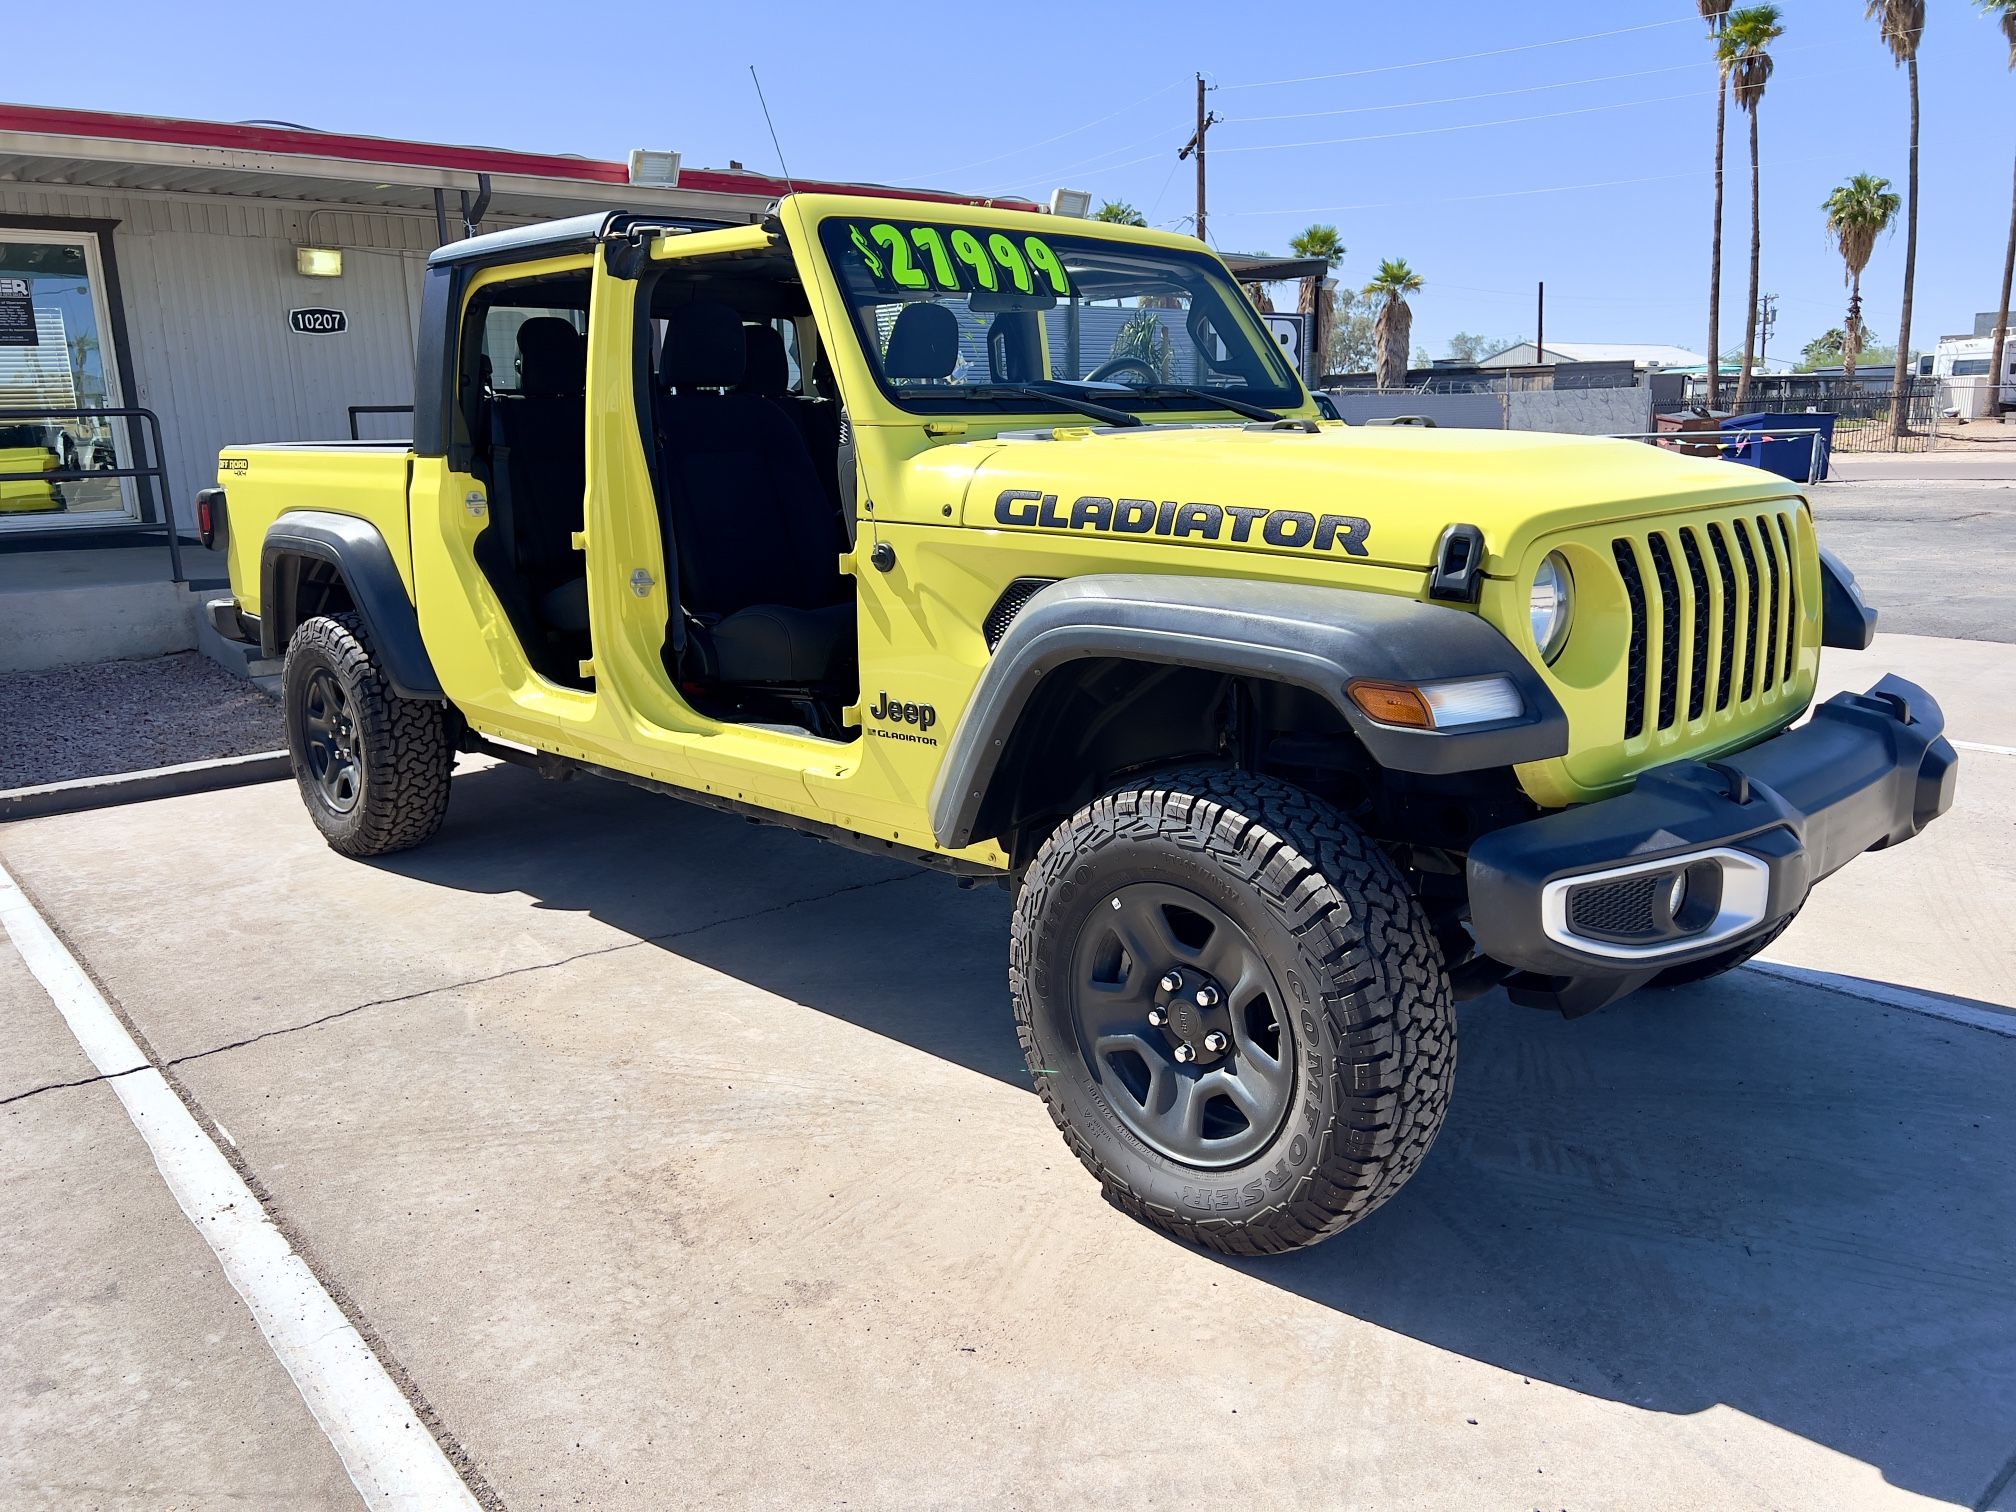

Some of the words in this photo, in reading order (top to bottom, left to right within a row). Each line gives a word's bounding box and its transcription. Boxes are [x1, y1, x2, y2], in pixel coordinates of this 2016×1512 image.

[0, 279, 28, 296] ER
[297, 313, 340, 329] 10207
[994, 489, 1371, 556] GLADIATOR
[870, 690, 936, 731] Jeep
[877, 729, 938, 747] GLADIATOR
[1183, 968, 1324, 1211] COMFORSER
